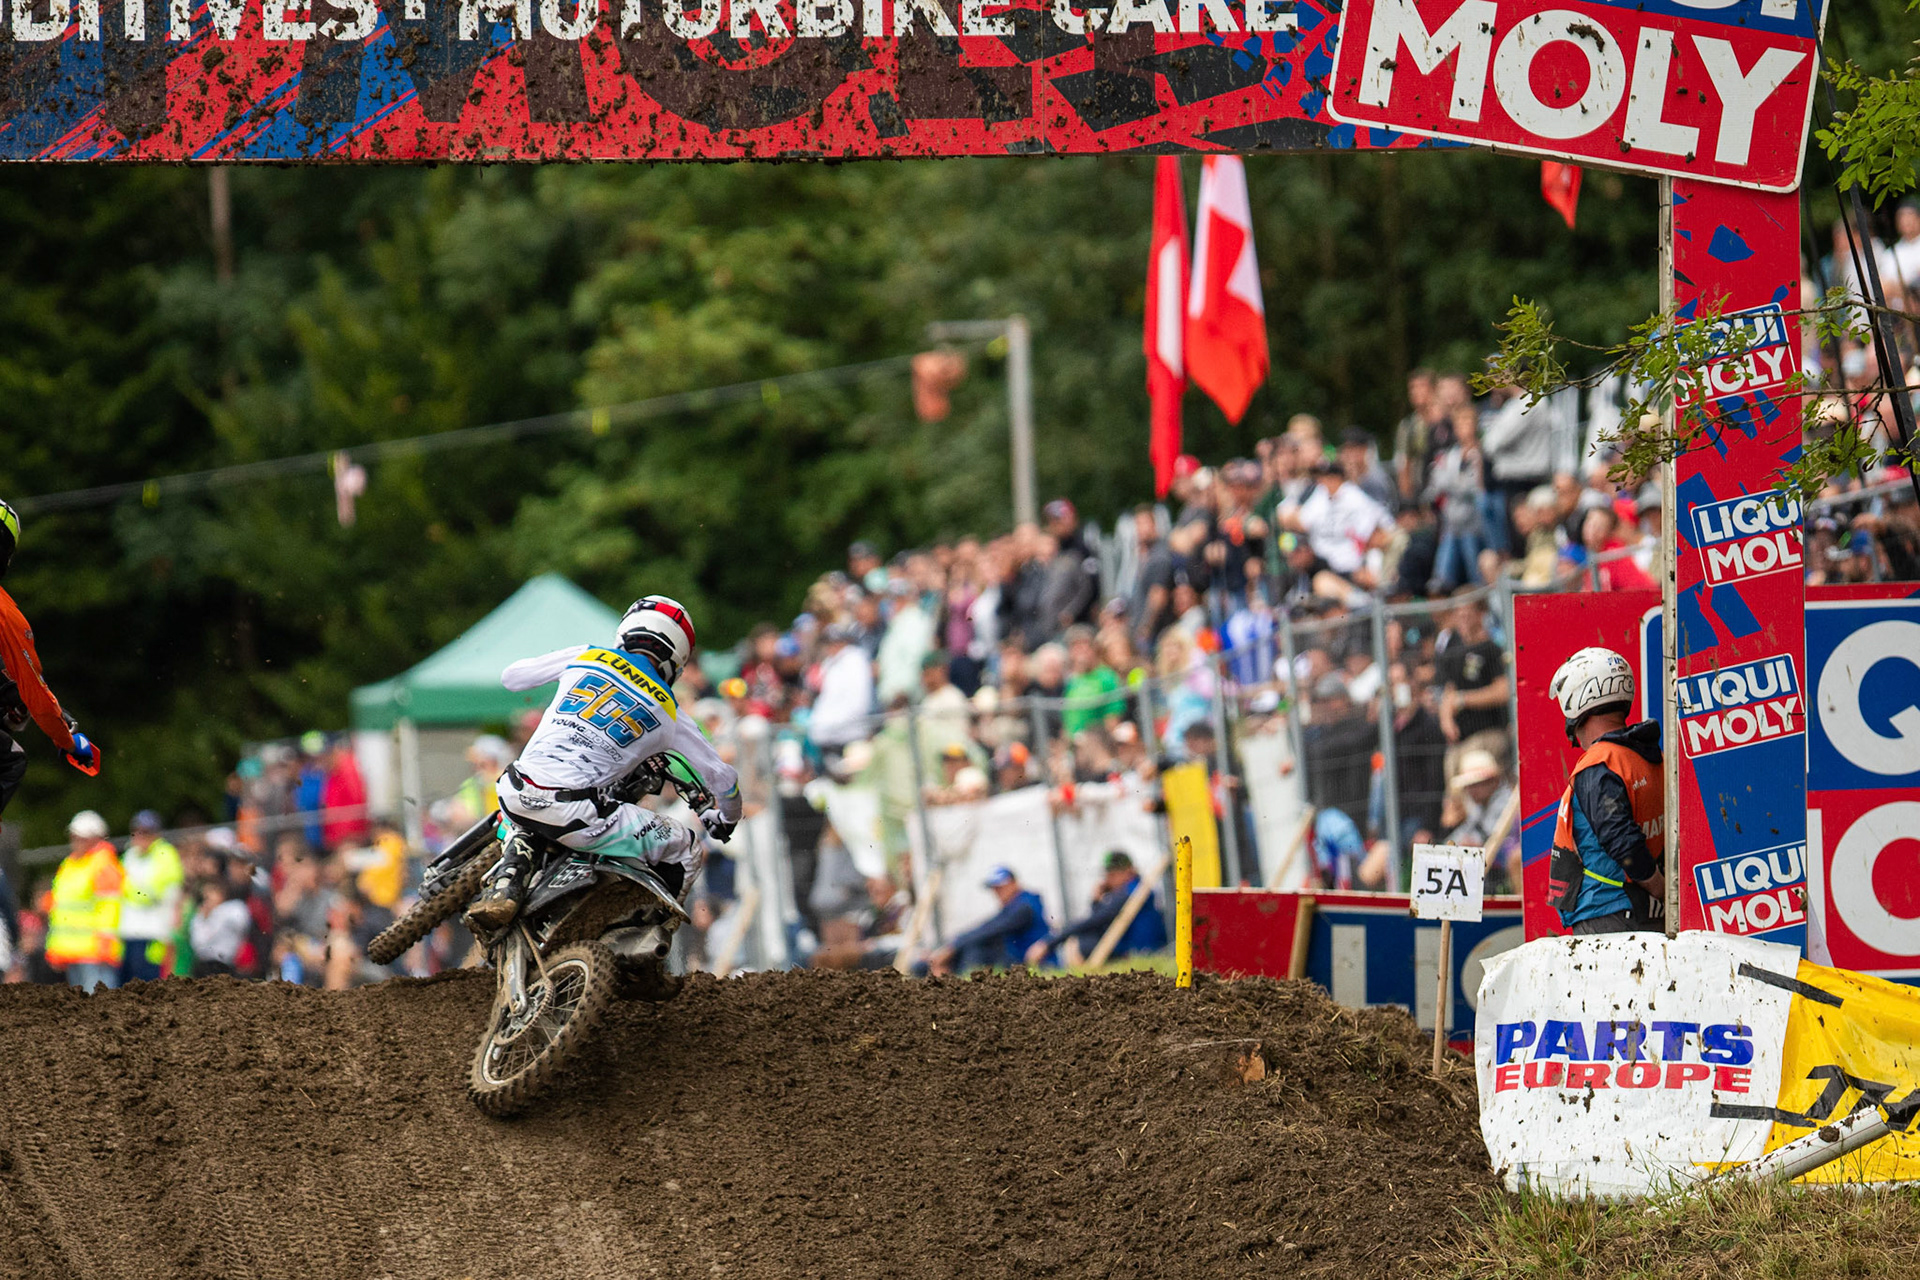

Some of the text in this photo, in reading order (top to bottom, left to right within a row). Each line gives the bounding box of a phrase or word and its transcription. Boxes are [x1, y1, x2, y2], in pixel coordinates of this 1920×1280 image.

[1358, 0, 1807, 165] MOLY
[595, 653, 669, 703] LÜNING
[1678, 660, 1791, 715] LIQUI
[1686, 696, 1798, 753] MOLY
[1425, 867, 1468, 896] 5A
[1496, 1020, 1754, 1066] PARTS
[1495, 1061, 1752, 1093] EUROPE
